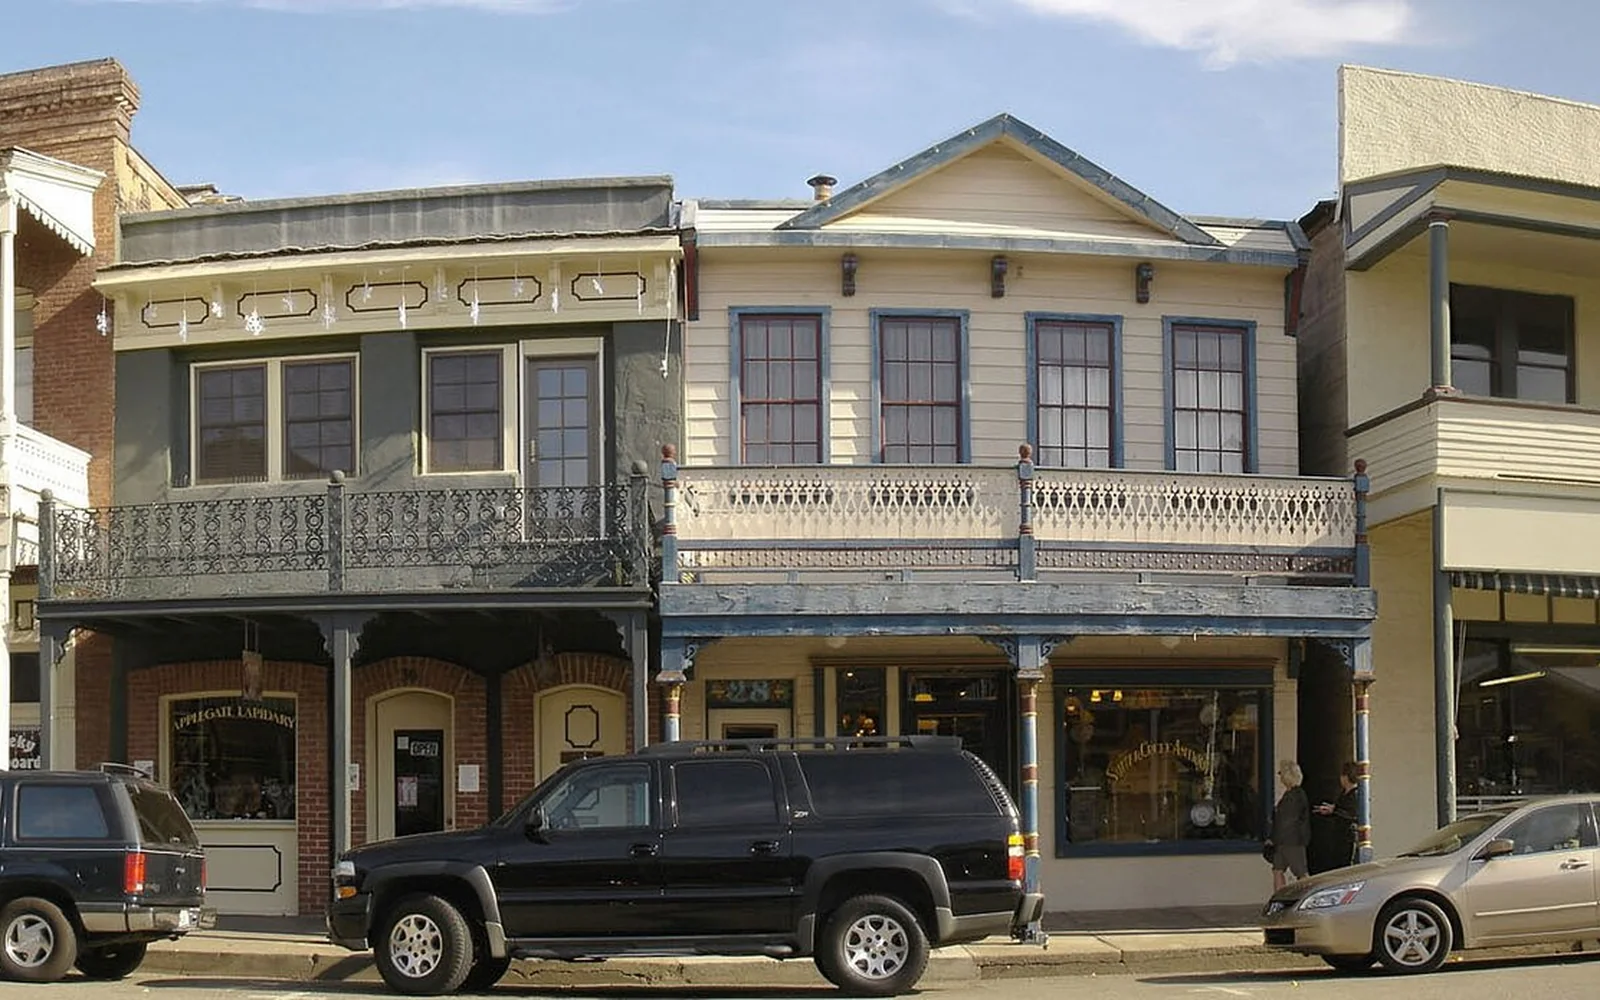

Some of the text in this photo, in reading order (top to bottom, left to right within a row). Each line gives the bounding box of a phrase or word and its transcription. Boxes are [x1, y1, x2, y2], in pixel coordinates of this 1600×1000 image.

[727, 681, 770, 702] 28
[173, 706, 296, 730] APPLEGATE LAPIDARY
[10, 735, 36, 752] eky
[411, 742, 438, 756] OPEN
[11, 755, 41, 769] oard
